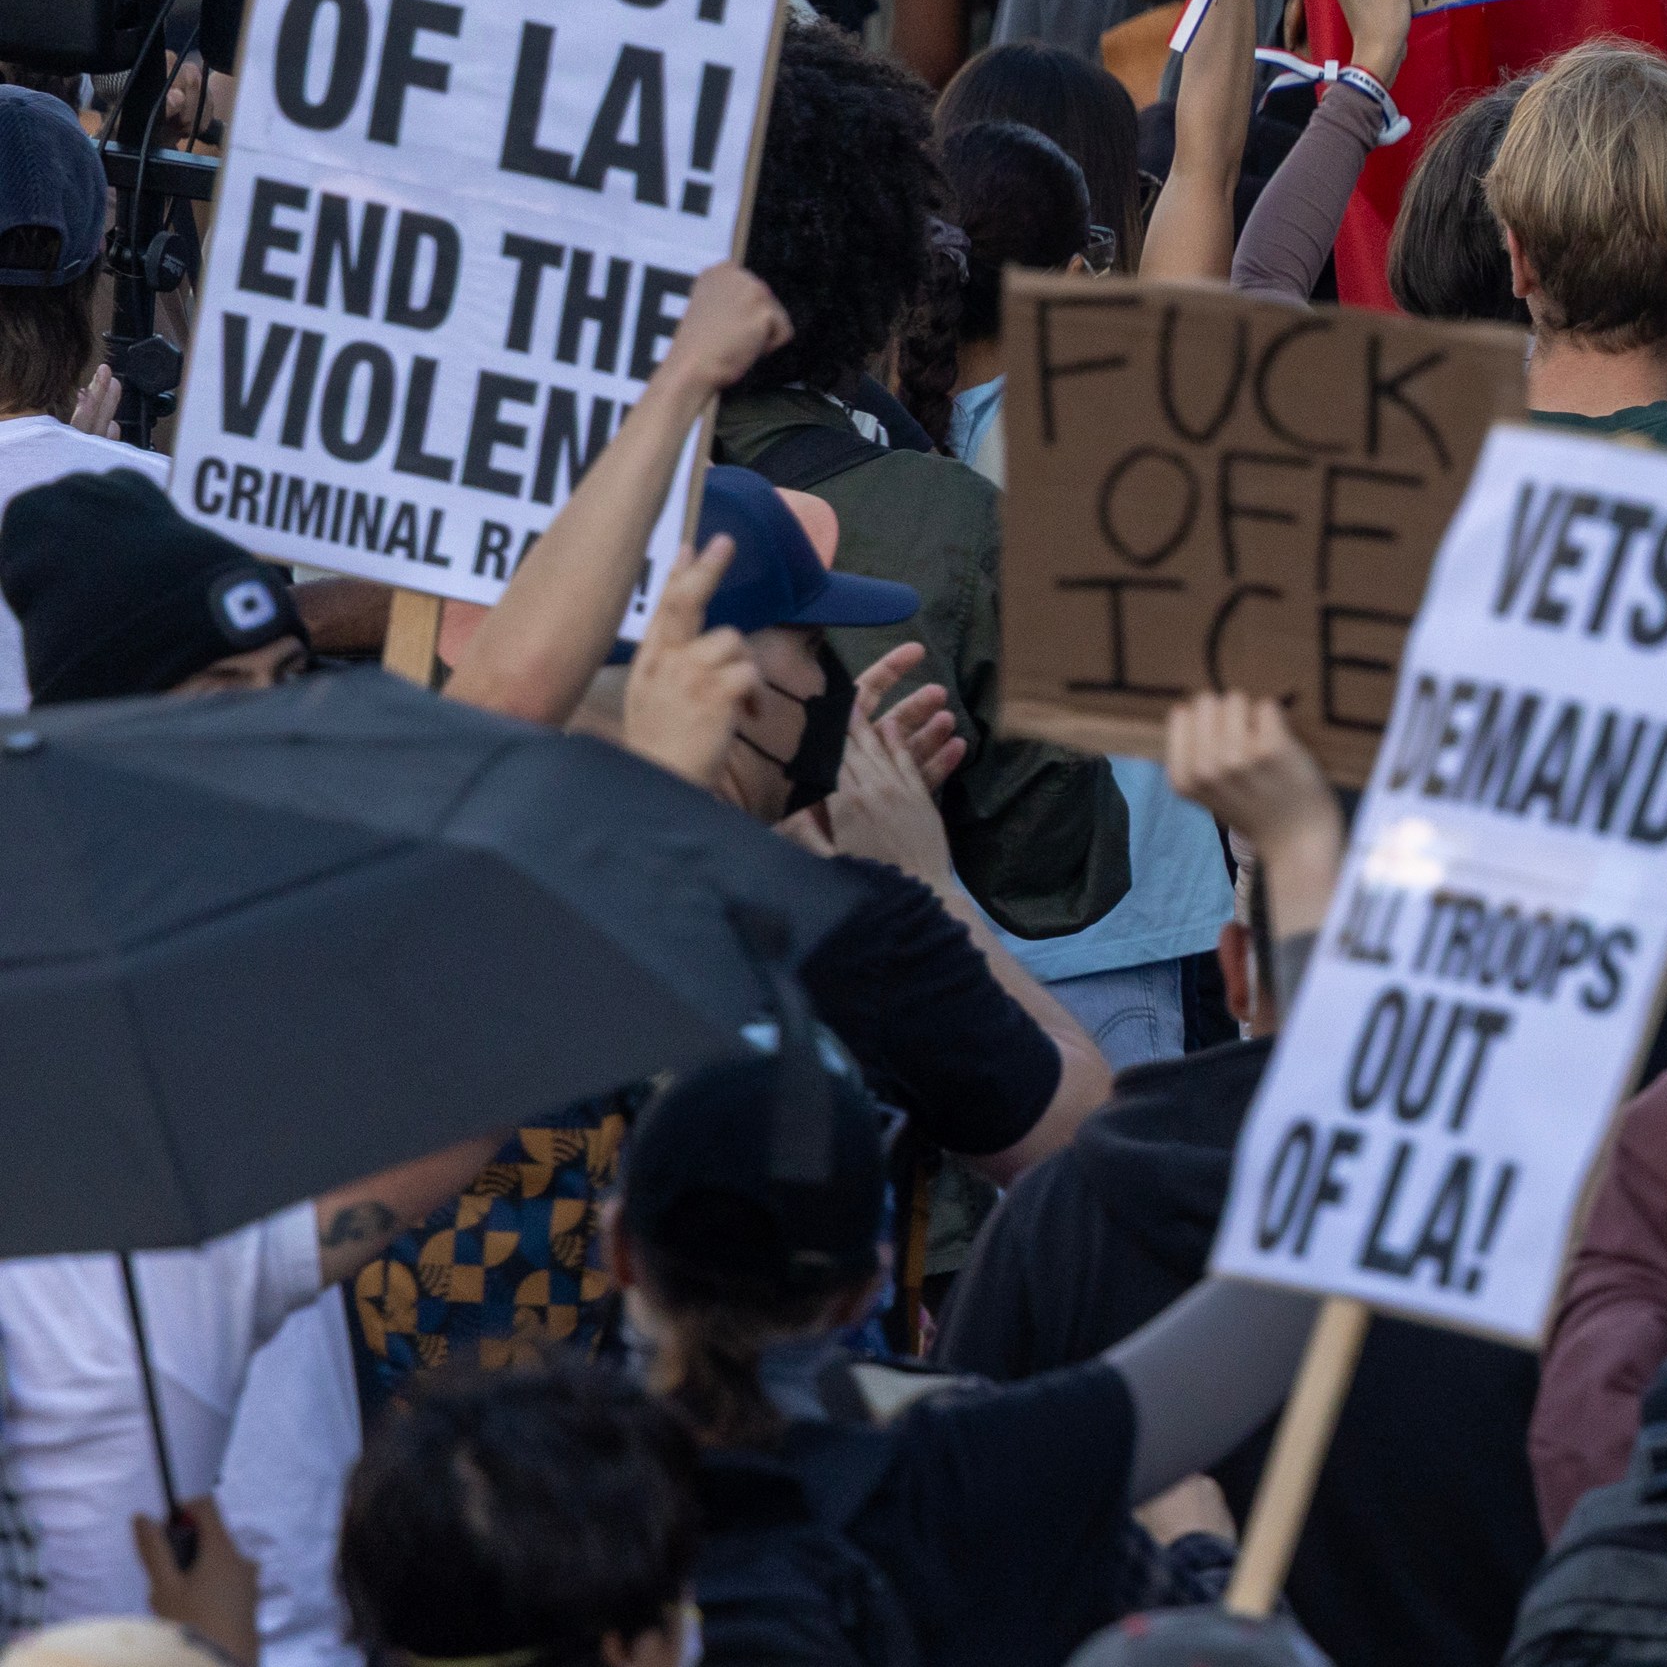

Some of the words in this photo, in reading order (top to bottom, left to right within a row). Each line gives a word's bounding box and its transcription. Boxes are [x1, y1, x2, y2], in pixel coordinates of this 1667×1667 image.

[497, 20, 734, 219] LA!
[236, 177, 462, 334] END
[500, 231, 699, 383] THE
[220, 310, 640, 507] VIOLEN
[1033, 295, 1451, 473] FUCK
[194, 454, 453, 569] CRIMINAL
[1098, 445, 1424, 593] OFF
[1056, 576, 1404, 733] ICE
[1326, 883, 1397, 969] ALL
[1413, 886, 1636, 1016] TROOPS
[1345, 989, 1509, 1135] OUT
[1255, 1121, 1356, 1256] OF
[1359, 1147, 1520, 1297] LA!
